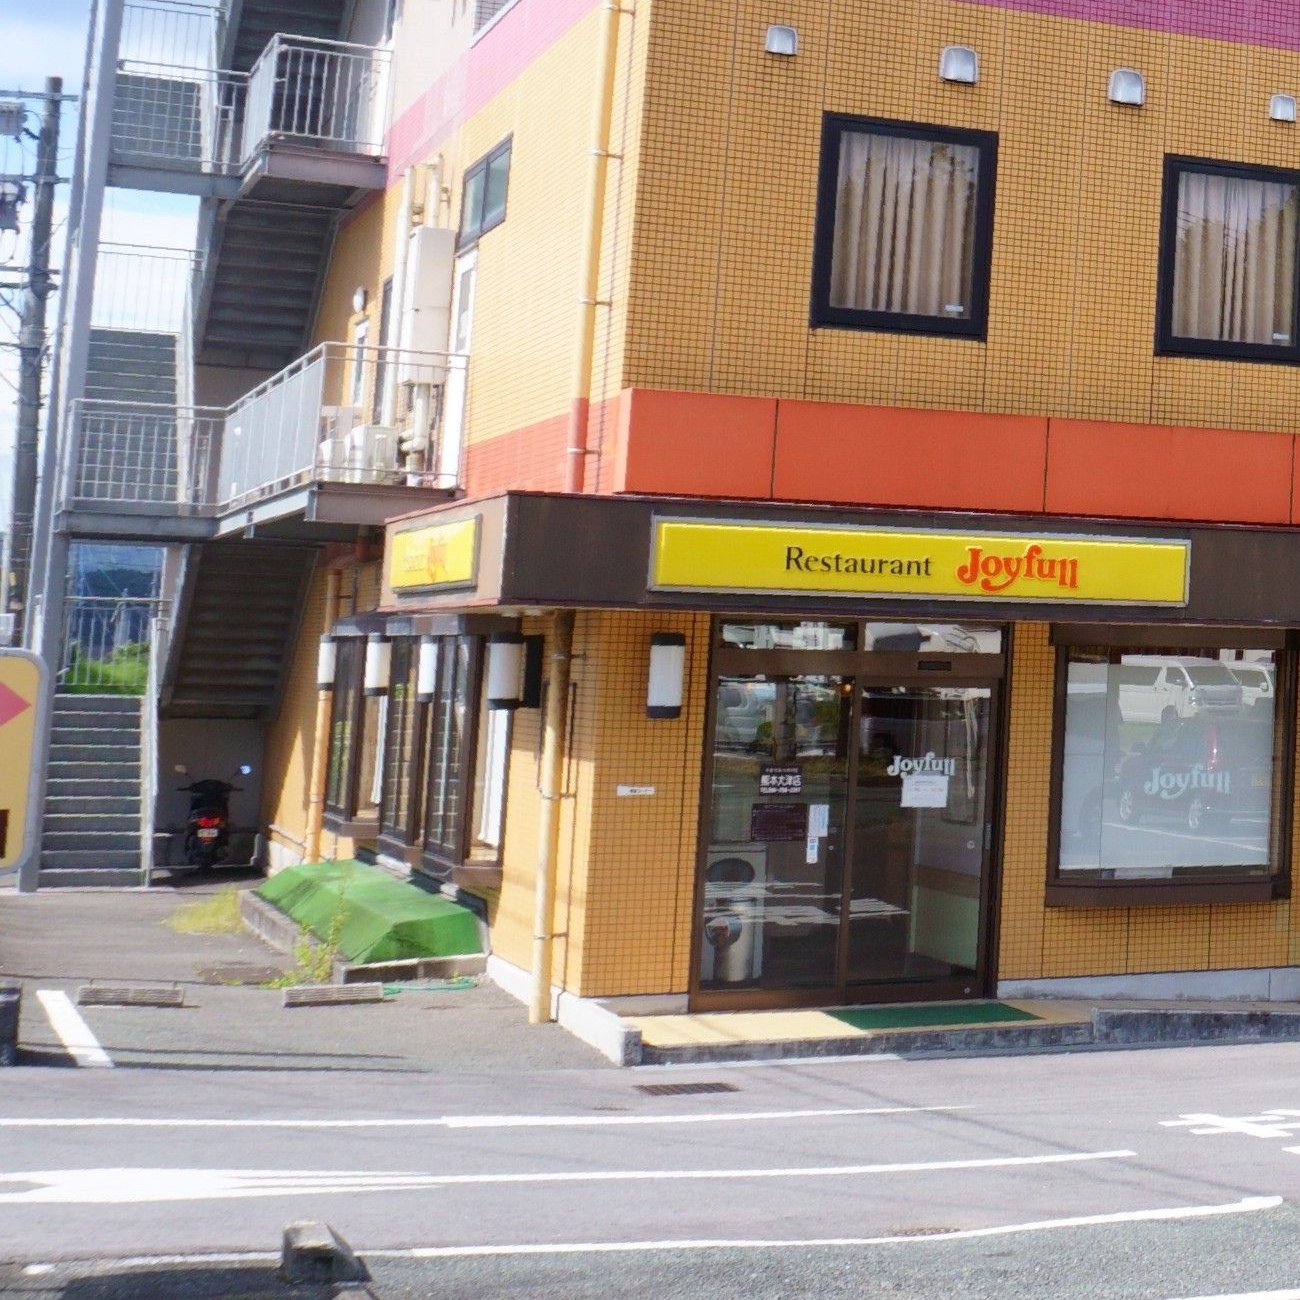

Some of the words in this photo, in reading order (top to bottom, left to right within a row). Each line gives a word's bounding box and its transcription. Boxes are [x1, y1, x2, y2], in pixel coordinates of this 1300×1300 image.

[783, 545, 933, 577] Restaurant
[955, 543, 1081, 592] Joyfull
[887, 751, 956, 779] Joyfull
[1143, 762, 1232, 798] Joyfull
